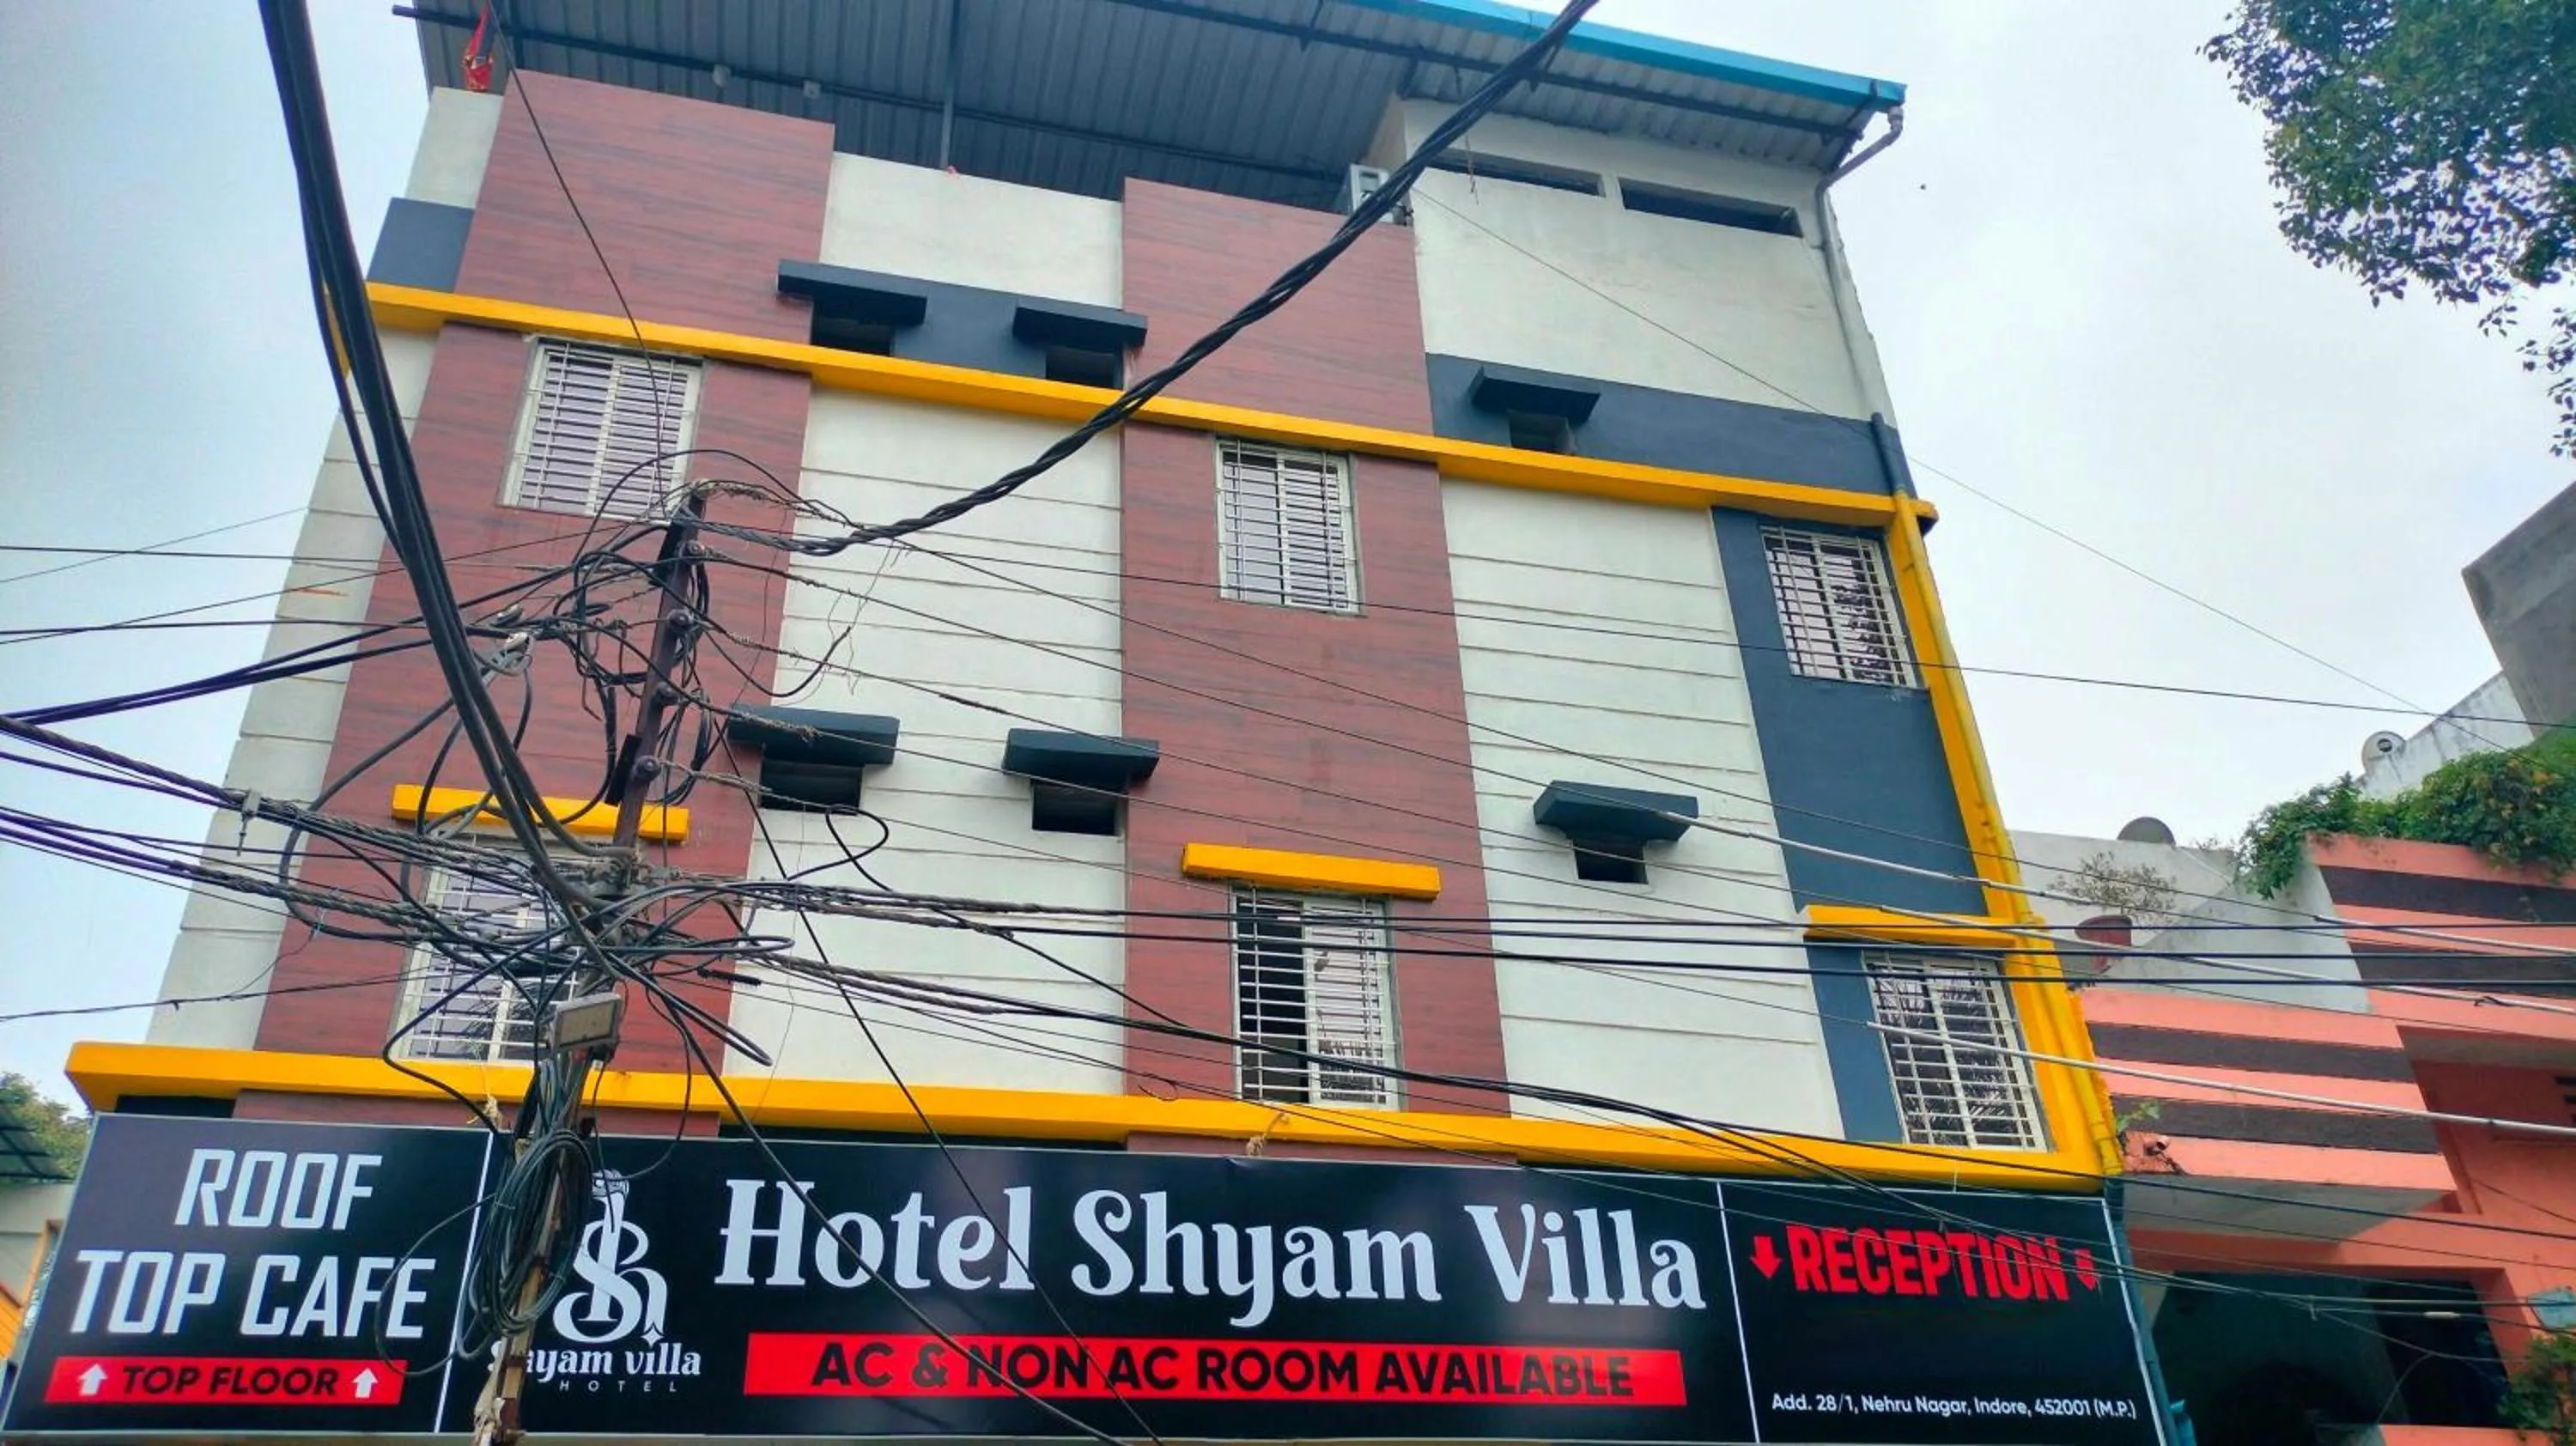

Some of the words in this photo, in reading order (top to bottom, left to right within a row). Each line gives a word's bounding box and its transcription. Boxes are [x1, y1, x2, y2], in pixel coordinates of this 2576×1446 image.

[174, 1148, 382, 1230] ROOF
[714, 1178, 1035, 1291] Hotel
[1071, 1189, 1443, 1328] Shyam
[1464, 1204, 1707, 1309] Villa
[1786, 1224, 2070, 1301] RECEPTION
[70, 1249, 226, 1334] TOP
[240, 1255, 436, 1339] CAFE
[122, 1365, 200, 1393] TOP
[209, 1368, 338, 1395] FLOOR
[558, 1380, 677, 1393] HOTEL
[625, 1342, 702, 1376] villa
[812, 1342, 894, 1388] AC
[910, 1343, 953, 1388] &
[966, 1346, 1091, 1389] NON
[1104, 1348, 1180, 1389] AC
[1202, 1349, 1360, 1393] ROOM
[1374, 1351, 1635, 1397] AVAILABLE
[1771, 1393, 1813, 1411] Add.
[1815, 1394, 1859, 1414] 28/1,
[1861, 1395, 1912, 1413] Nehru
[1915, 1396, 1971, 1417] Nagar,
[1974, 1396, 2032, 1418] Indore,
[2034, 1399, 2091, 1416] 452001
[2093, 1399, 2137, 1419] (M.P.)
